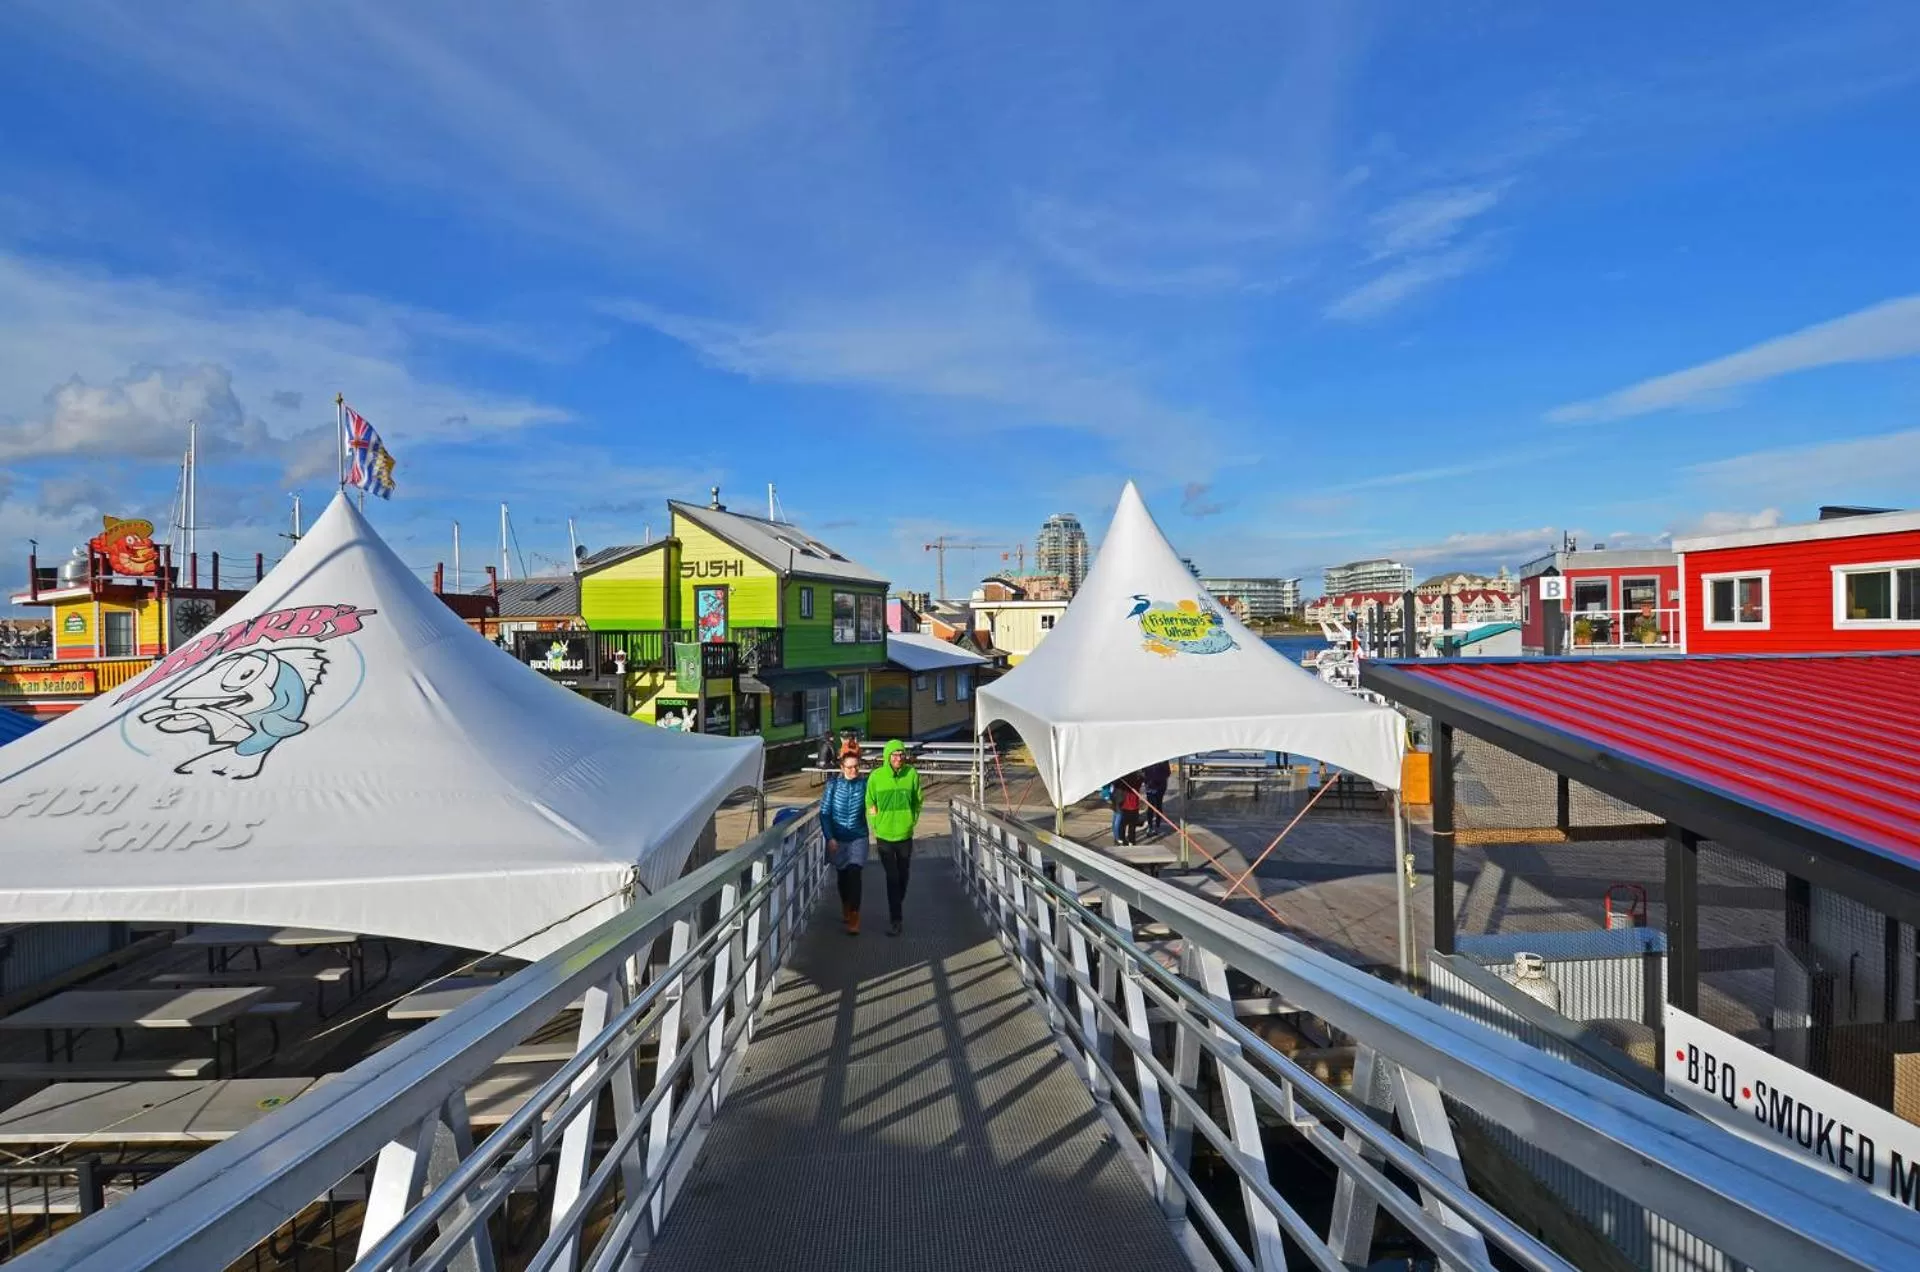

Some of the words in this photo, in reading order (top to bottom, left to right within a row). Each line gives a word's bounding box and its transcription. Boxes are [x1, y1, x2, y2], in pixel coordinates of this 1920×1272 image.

[680, 560, 743, 578] SUSHI
[1546, 580, 1561, 597] B
[1164, 626, 1198, 637] Wharf
[43, 677, 85, 692] Seafood
[0, 784, 139, 819] FISH
[82, 818, 267, 854] CHIPS
[1687, 1043, 1738, 1110] BBQ
[1755, 1080, 1875, 1185] SMOKED
